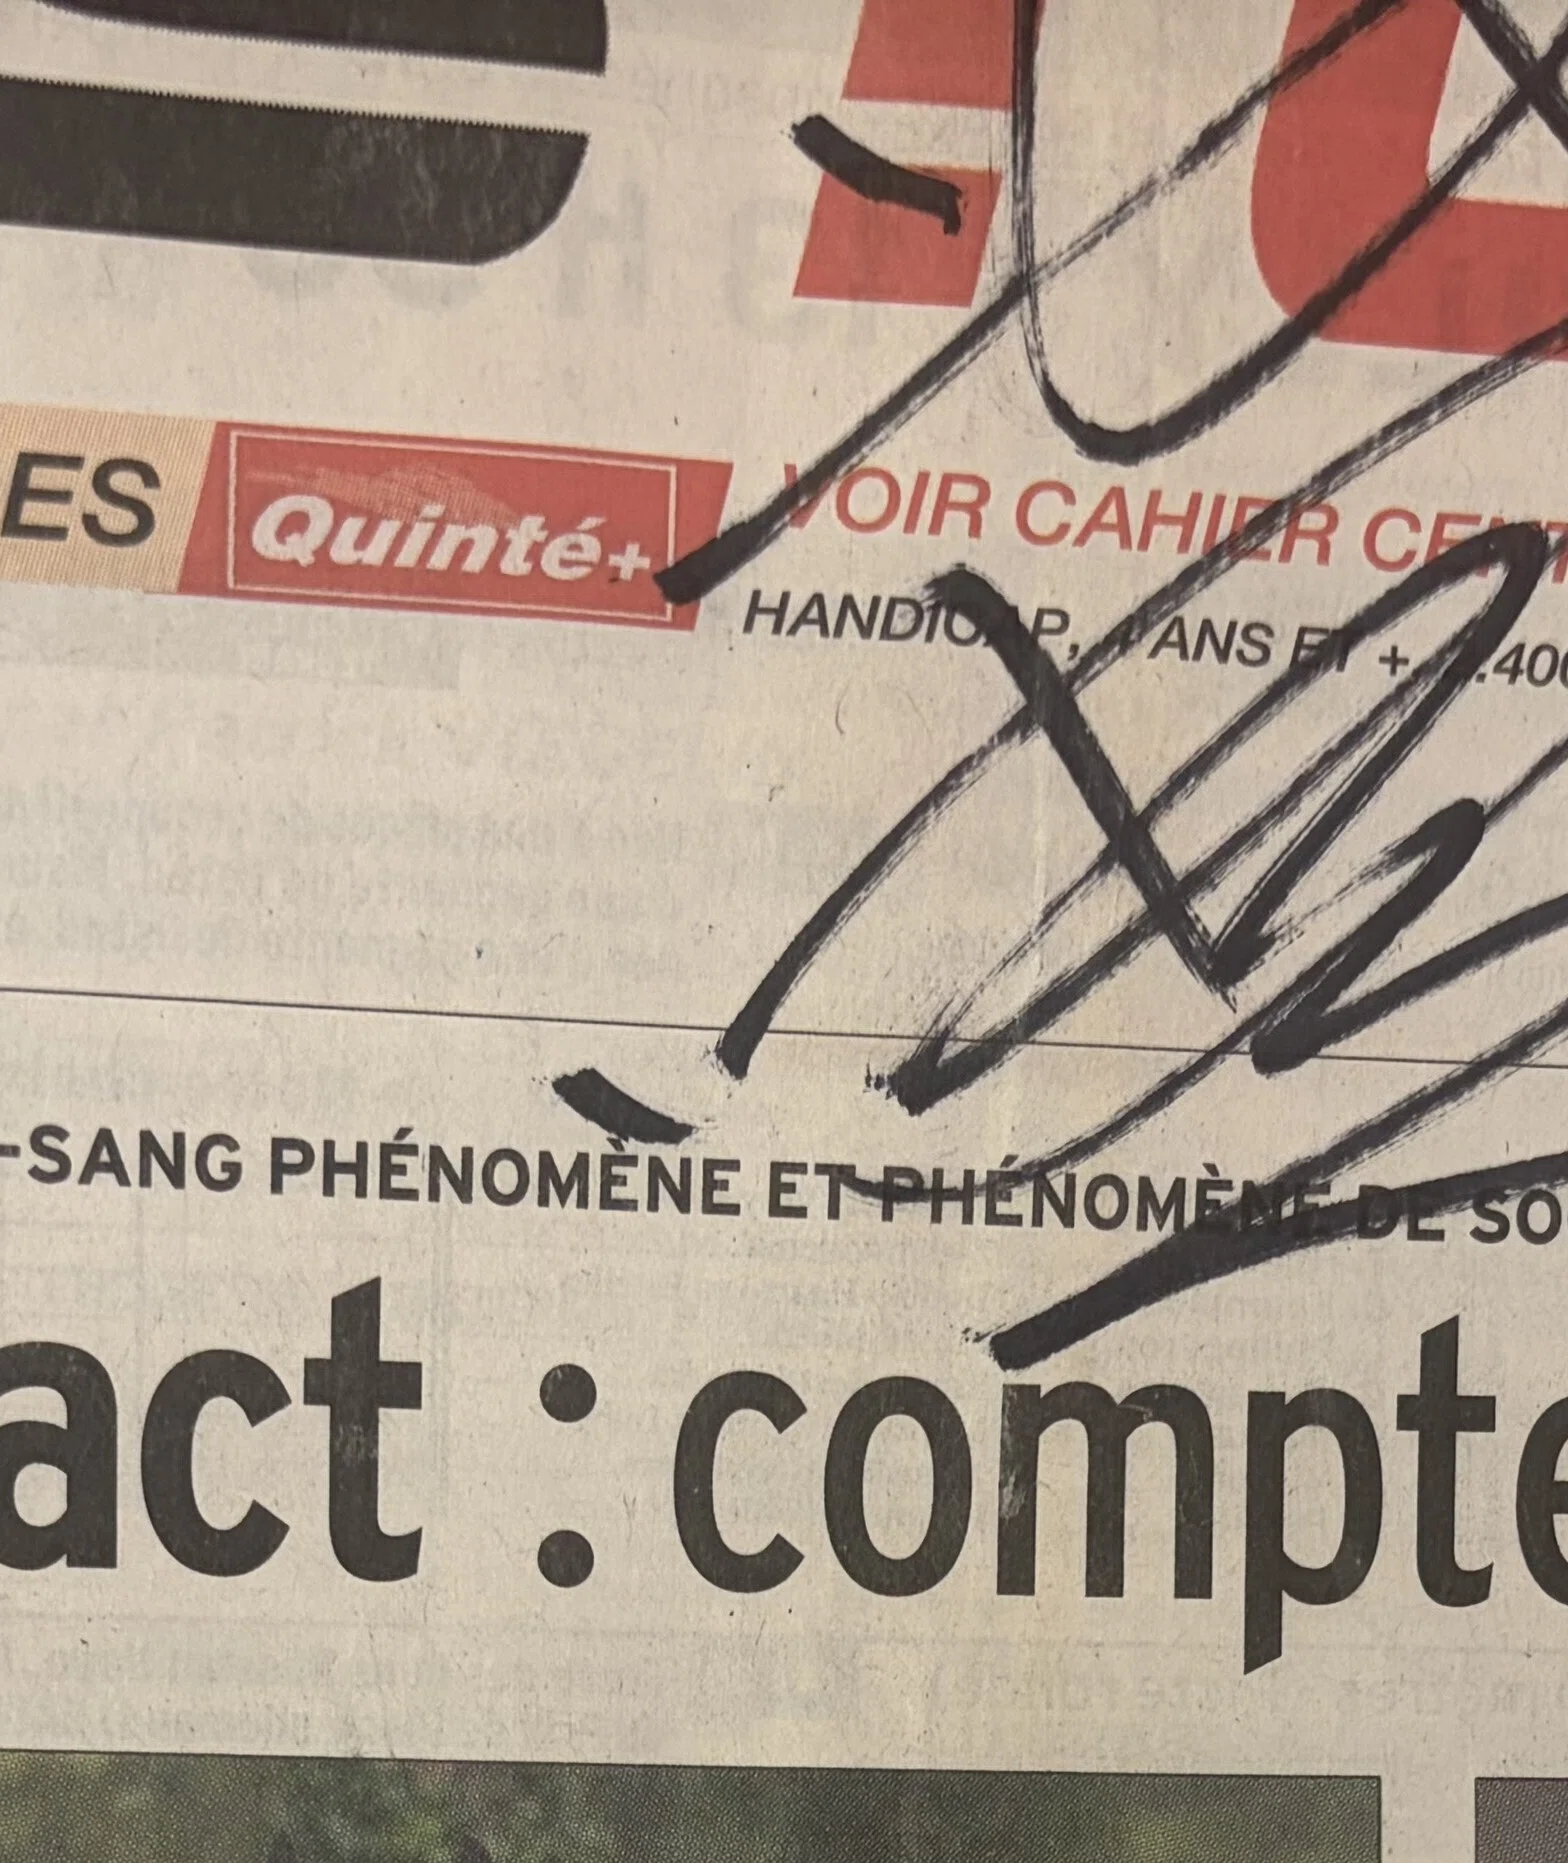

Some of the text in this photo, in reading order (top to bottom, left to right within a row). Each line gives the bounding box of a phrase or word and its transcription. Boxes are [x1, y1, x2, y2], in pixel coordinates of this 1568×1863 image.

[250, 488, 654, 588] Quinté+
[782, 462, 992, 540] VOIR
[1015, 479, 1340, 564] CAHIER
[742, 589, 1080, 660] HANDICP,
[1148, 616, 1275, 667] ANS
[269, 1126, 741, 1217] PHÉNOMÈNE
[767, 1160, 856, 1219] ET
[536, 1362, 598, 1589] :
